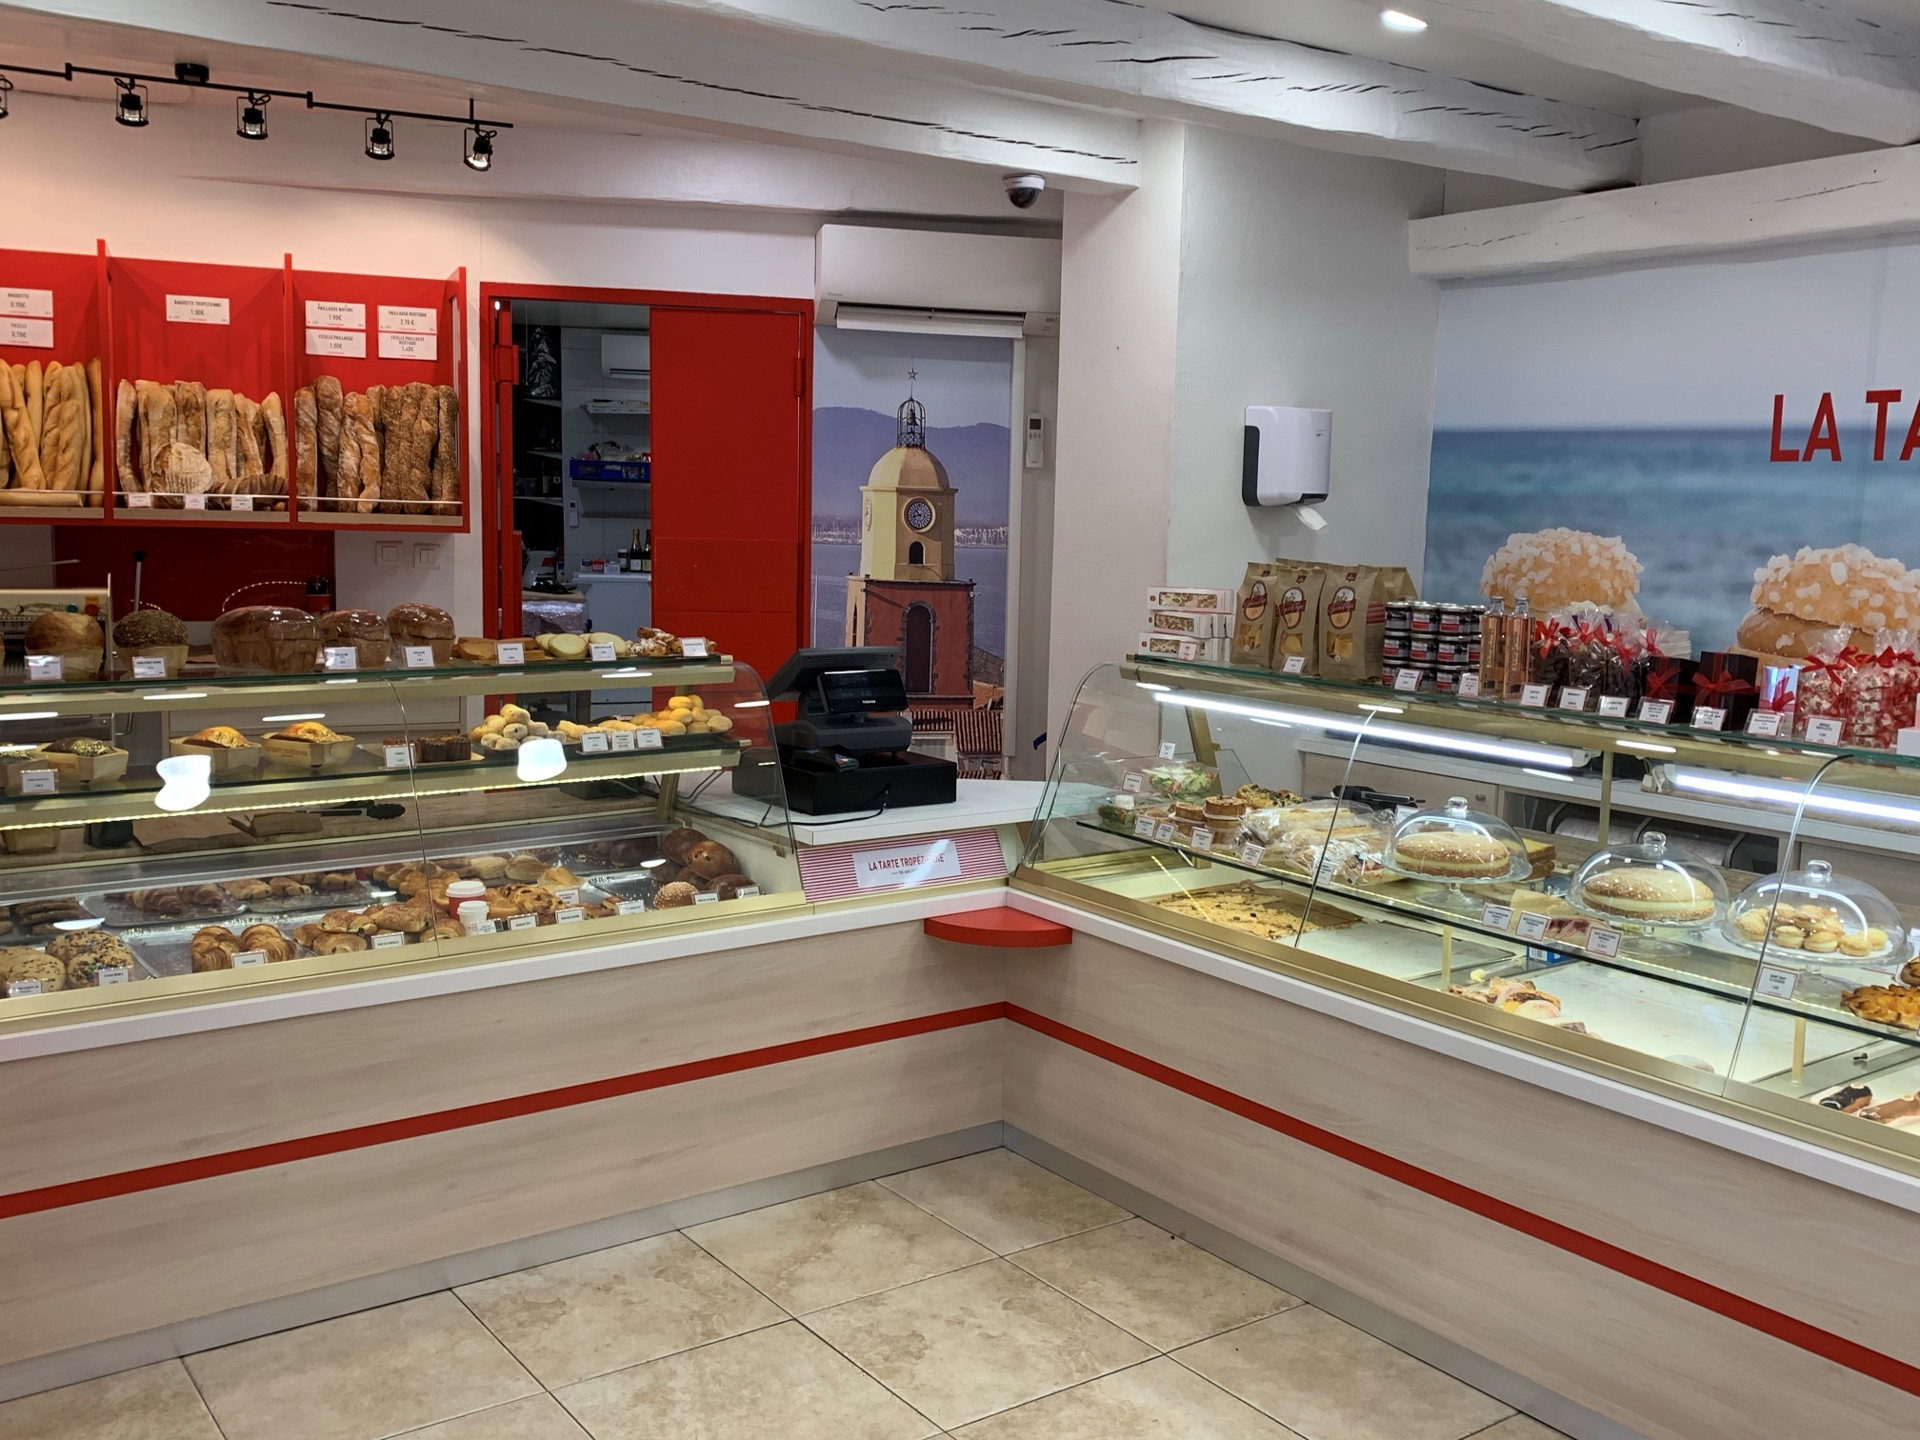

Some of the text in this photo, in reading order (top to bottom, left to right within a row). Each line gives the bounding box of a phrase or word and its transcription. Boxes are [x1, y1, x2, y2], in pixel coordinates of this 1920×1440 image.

[1770, 392, 1842, 462] LA
[868, 861, 878, 871] LA
[878, 858, 900, 870] TARTE
